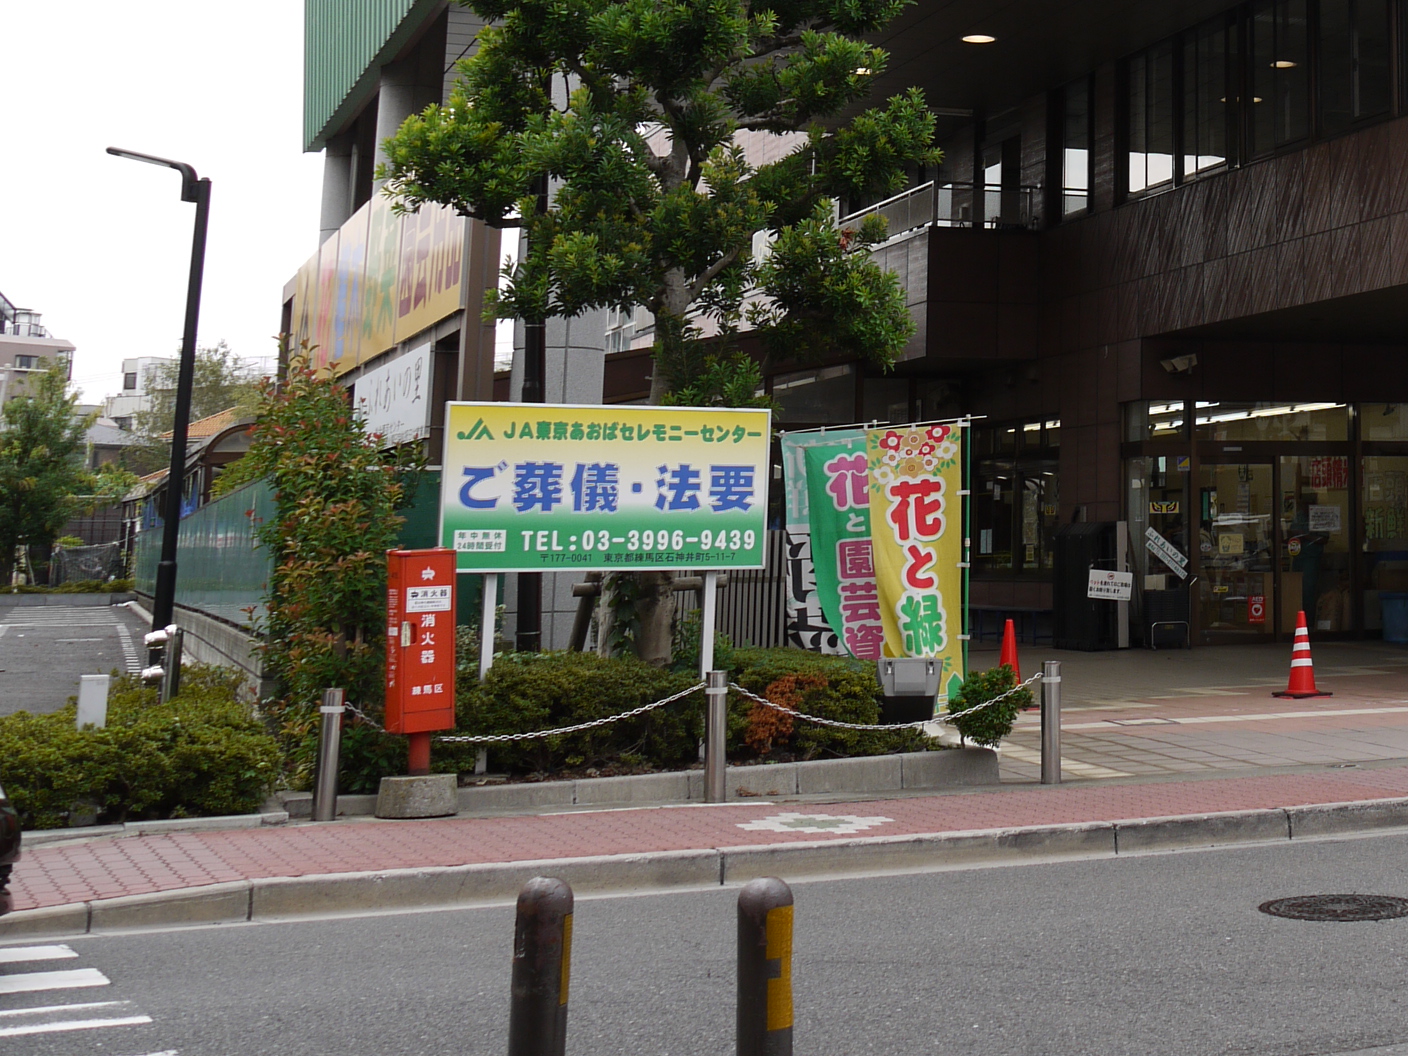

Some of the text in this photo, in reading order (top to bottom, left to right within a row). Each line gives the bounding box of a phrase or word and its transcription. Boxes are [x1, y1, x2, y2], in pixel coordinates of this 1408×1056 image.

[503, 421, 762, 444] JA東京あおばセレモニーセンター
[457, 459, 756, 513] ご葬儀・法要
[456, 541, 503, 550] 24時間受付
[457, 531, 503, 540] 年中無休
[520, 529, 756, 552] TEL:03-3996-9439
[603, 552, 736, 563] 東京都練馬区石神井町5-11-7
[889, 478, 944, 658] 花と緑
[420, 613, 437, 664] 消火器
[411, 683, 444, 696] 練馬区
